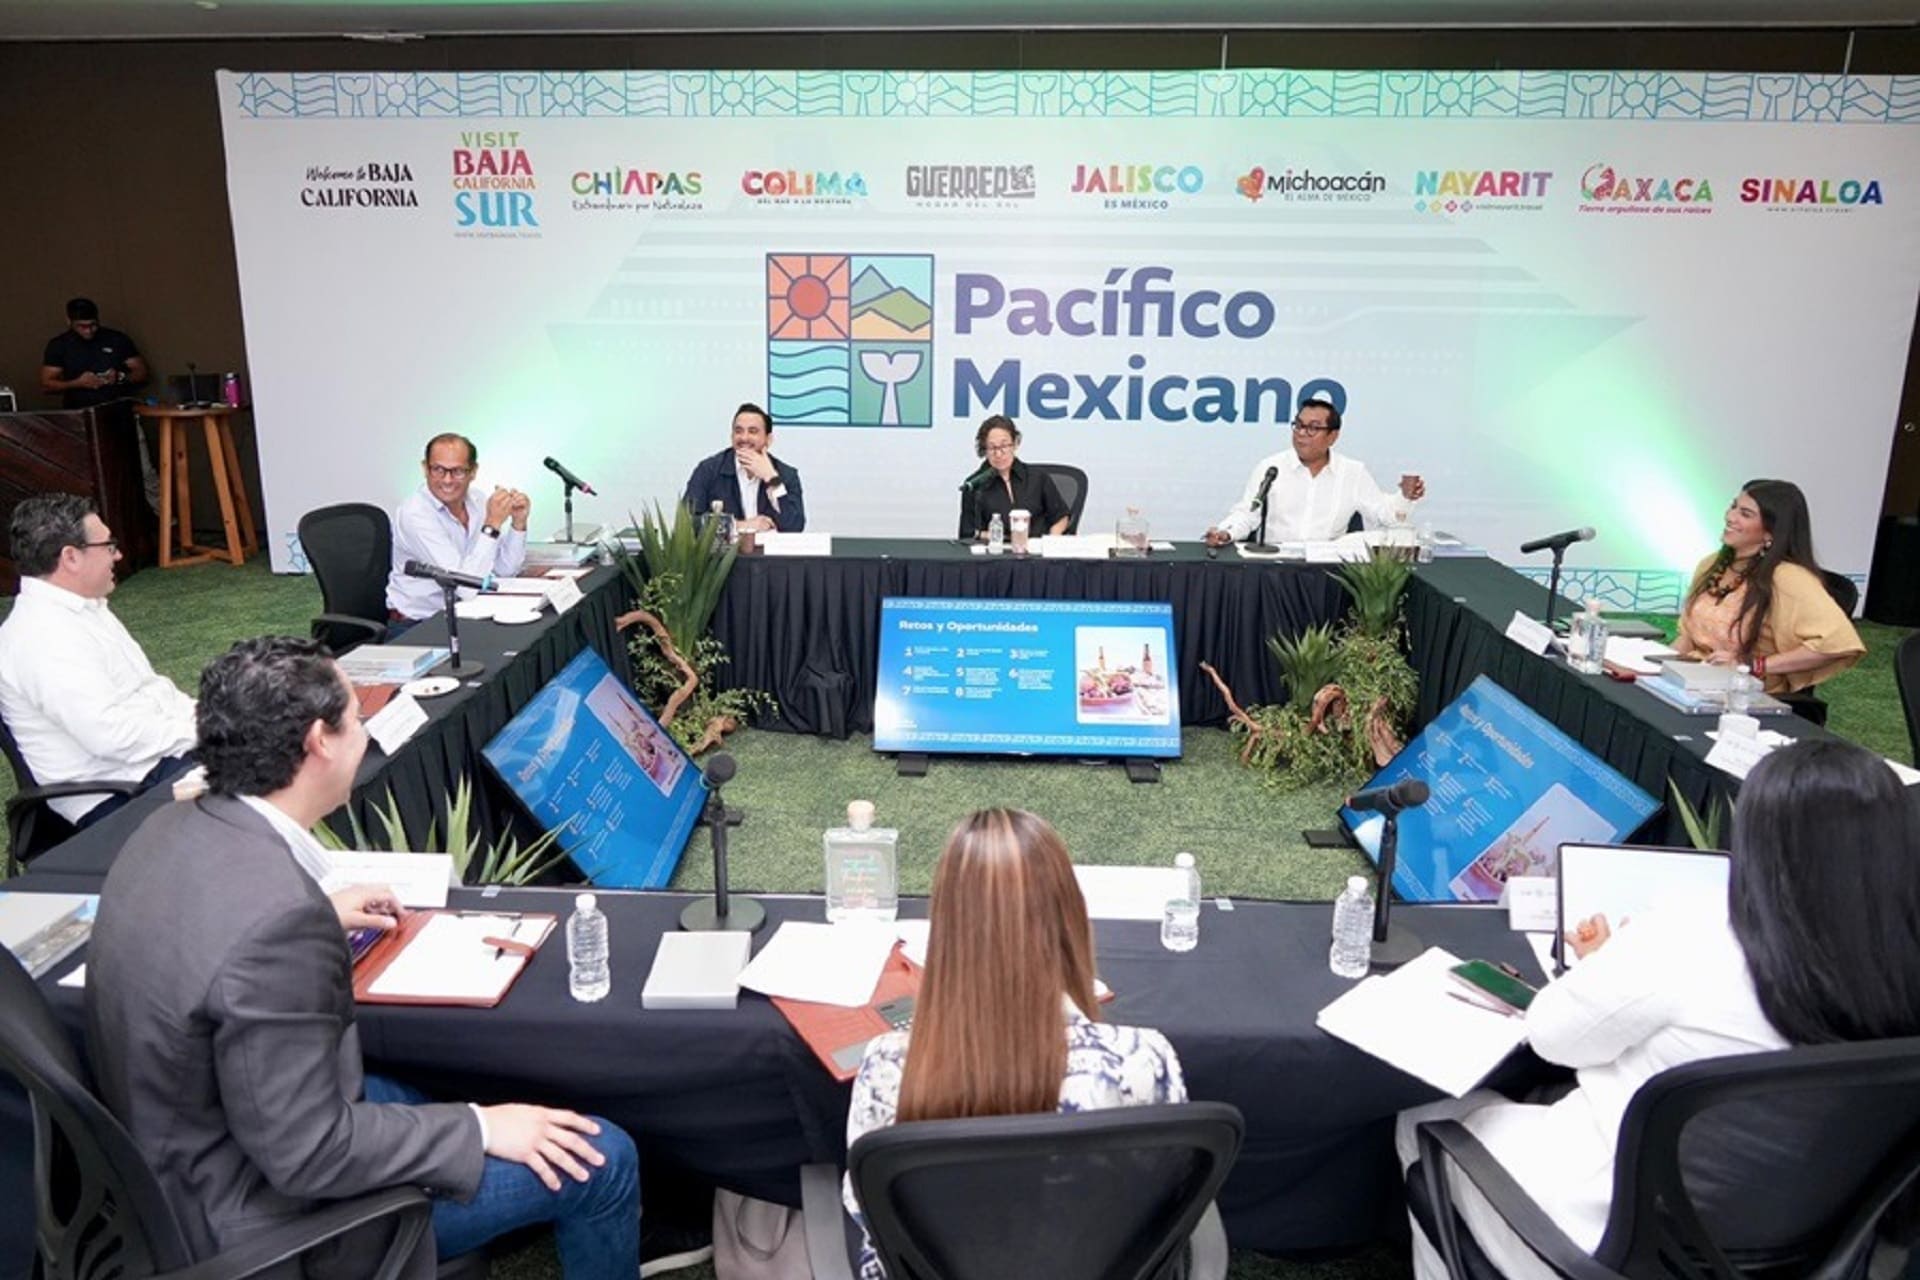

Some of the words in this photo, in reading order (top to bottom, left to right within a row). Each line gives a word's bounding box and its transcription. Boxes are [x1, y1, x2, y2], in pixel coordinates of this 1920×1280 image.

[461, 131, 520, 148] VISIT
[306, 165, 354, 181] Welcome
[368, 163, 414, 183] BAJA
[453, 149, 533, 176] BAJA
[453, 177, 536, 190] CALIFORNIA
[571, 165, 703, 195] CHIAPAS
[741, 169, 868, 197] COLIMA
[1071, 164, 1204, 193] JALISCO
[1267, 168, 1386, 194] Michoacán
[1415, 170, 1553, 197] NAYARIT
[1740, 178, 1883, 205] SINALOA
[300, 187, 419, 207] CALIFORNIA
[455, 191, 539, 227] SUR
[1104, 199, 1118, 209] ES
[1121, 198, 1169, 210] MÉXICO
[954, 267, 1275, 338] Pacífico
[899, 620, 934, 630] Retos
[937, 622, 945, 634] y
[947, 621, 1039, 634] Oportunidades
[956, 647, 965, 658] 2
